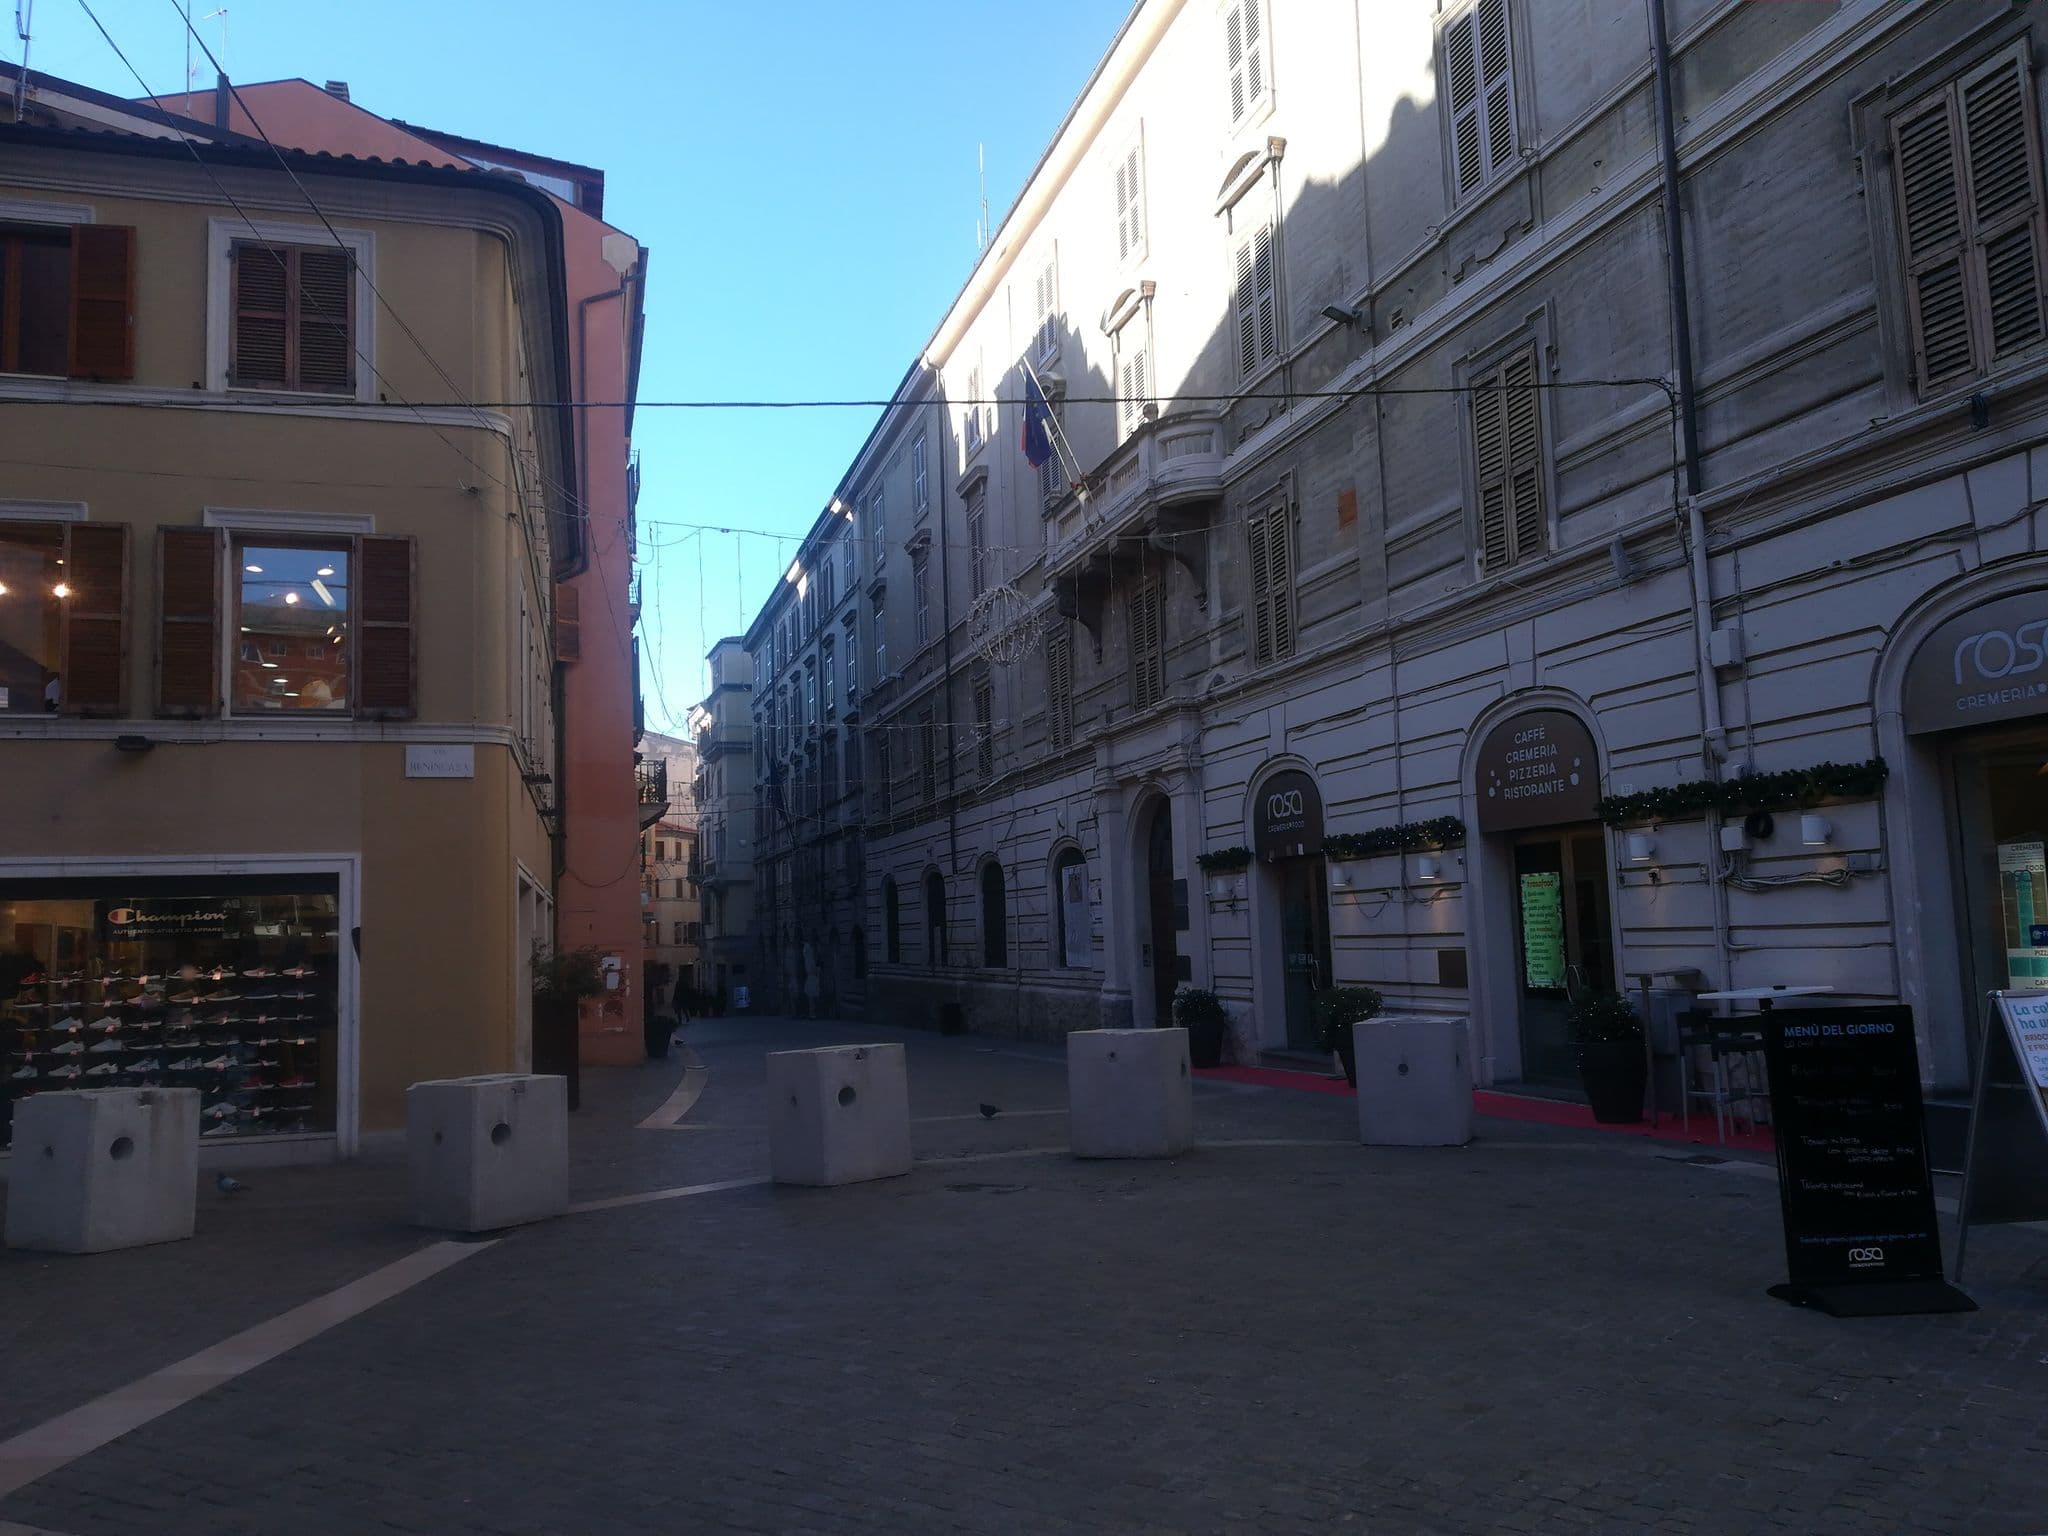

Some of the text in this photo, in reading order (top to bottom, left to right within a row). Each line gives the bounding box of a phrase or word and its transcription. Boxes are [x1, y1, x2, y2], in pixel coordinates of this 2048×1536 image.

[1954, 619, 2048, 685] ros
[1956, 685, 2037, 711] CREMERIA
[1505, 743, 1558, 764] CREMERIA
[1509, 762, 1556, 781] PIZZERIA
[1504, 779, 1565, 800] RISTORANTE
[1267, 790, 1303, 820] rosa
[108, 907, 226, 927] Champion
[112, 928, 154, 936] AUTHENTIC
[193, 926, 225, 934] APPAREL
[2013, 1005, 2031, 1016] La
[1784, 1022, 1895, 1037] MENÙ DEL GIORNO
[2018, 1018, 2037, 1029] ha
[1848, 1247, 1884, 1262] rosa
